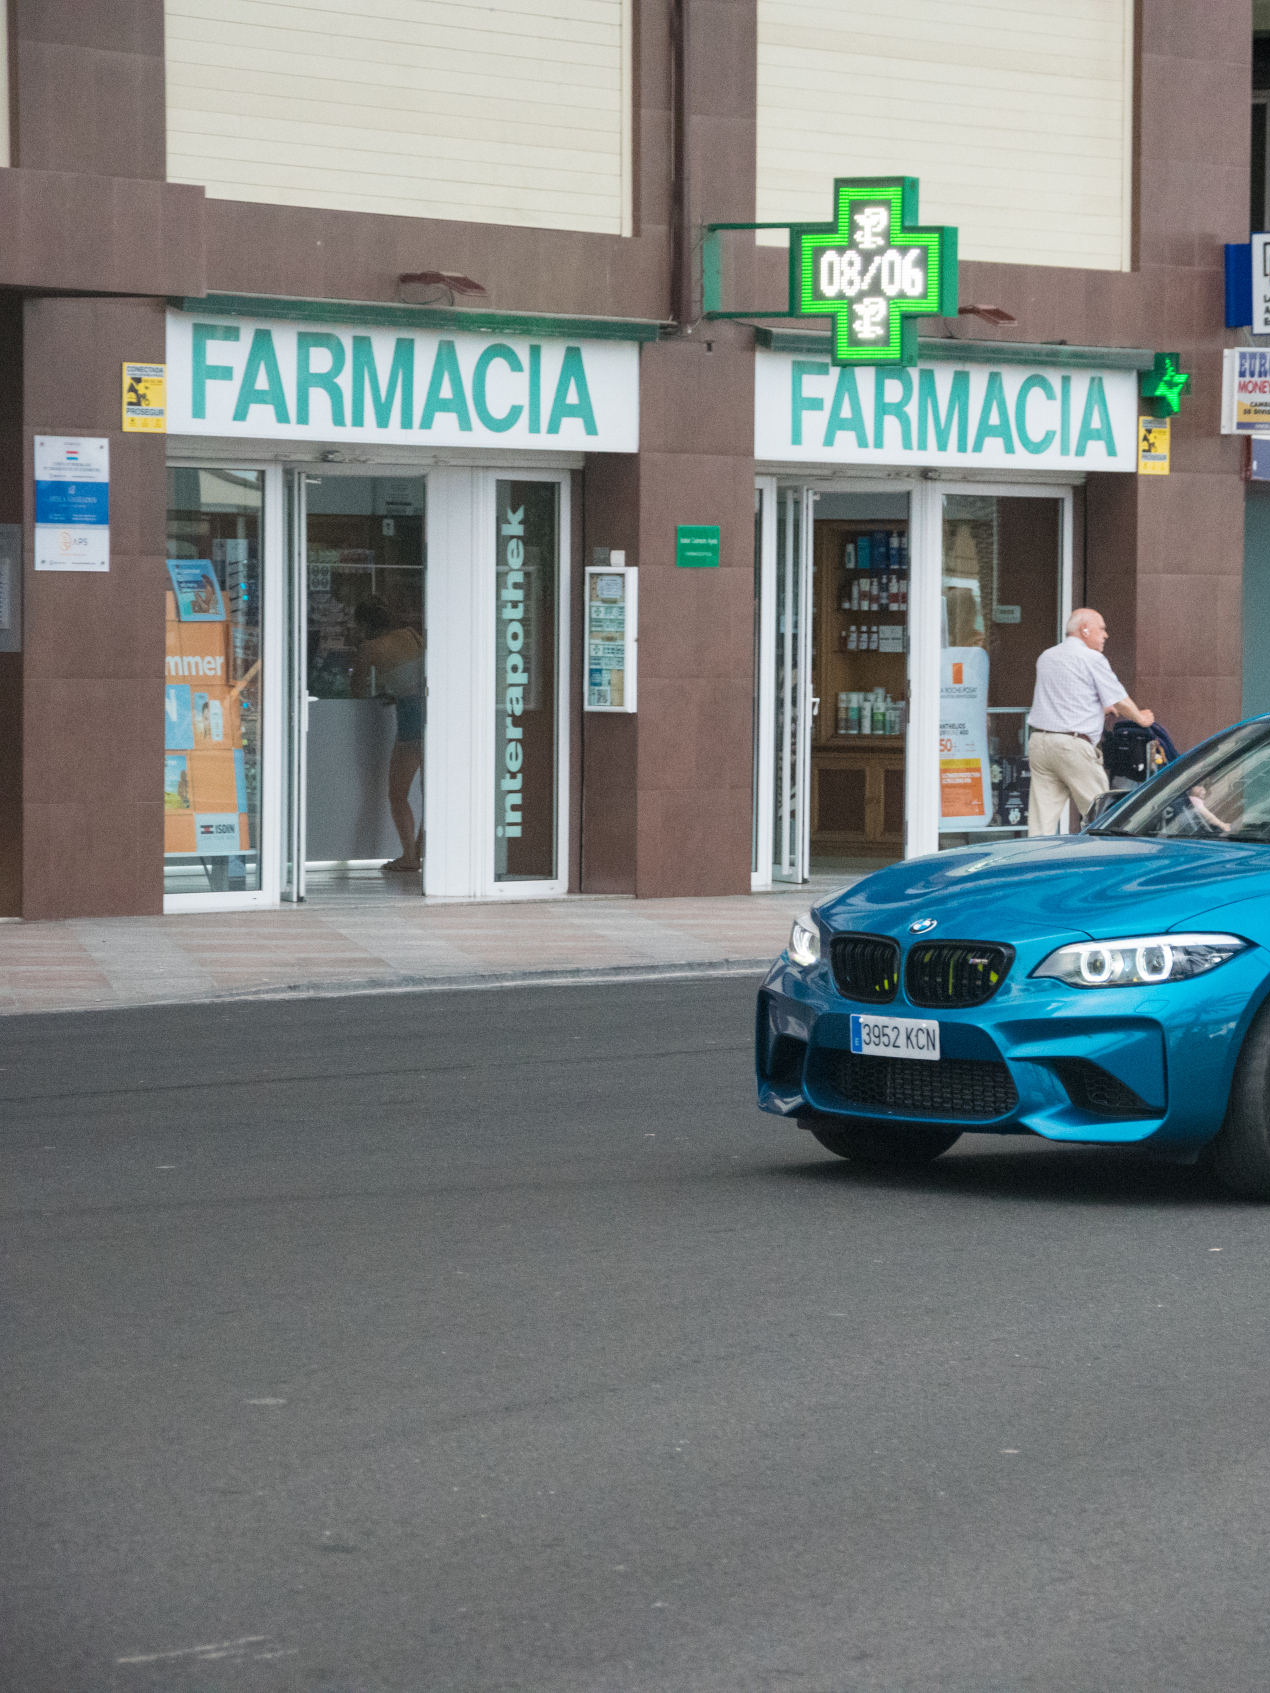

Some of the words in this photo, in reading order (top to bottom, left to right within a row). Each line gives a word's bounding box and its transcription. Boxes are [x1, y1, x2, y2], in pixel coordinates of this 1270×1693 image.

[819, 249, 924, 297] 08/06
[191, 322, 599, 437] FARMACIA
[126, 407, 164, 416] PROSEGUR
[790, 360, 1118, 459] FARMACIA
[497, 504, 526, 839] interapothek
[215, 824, 236, 835] ISDIN
[863, 1023, 901, 1048] 3952
[905, 1026, 936, 1051] KCN
